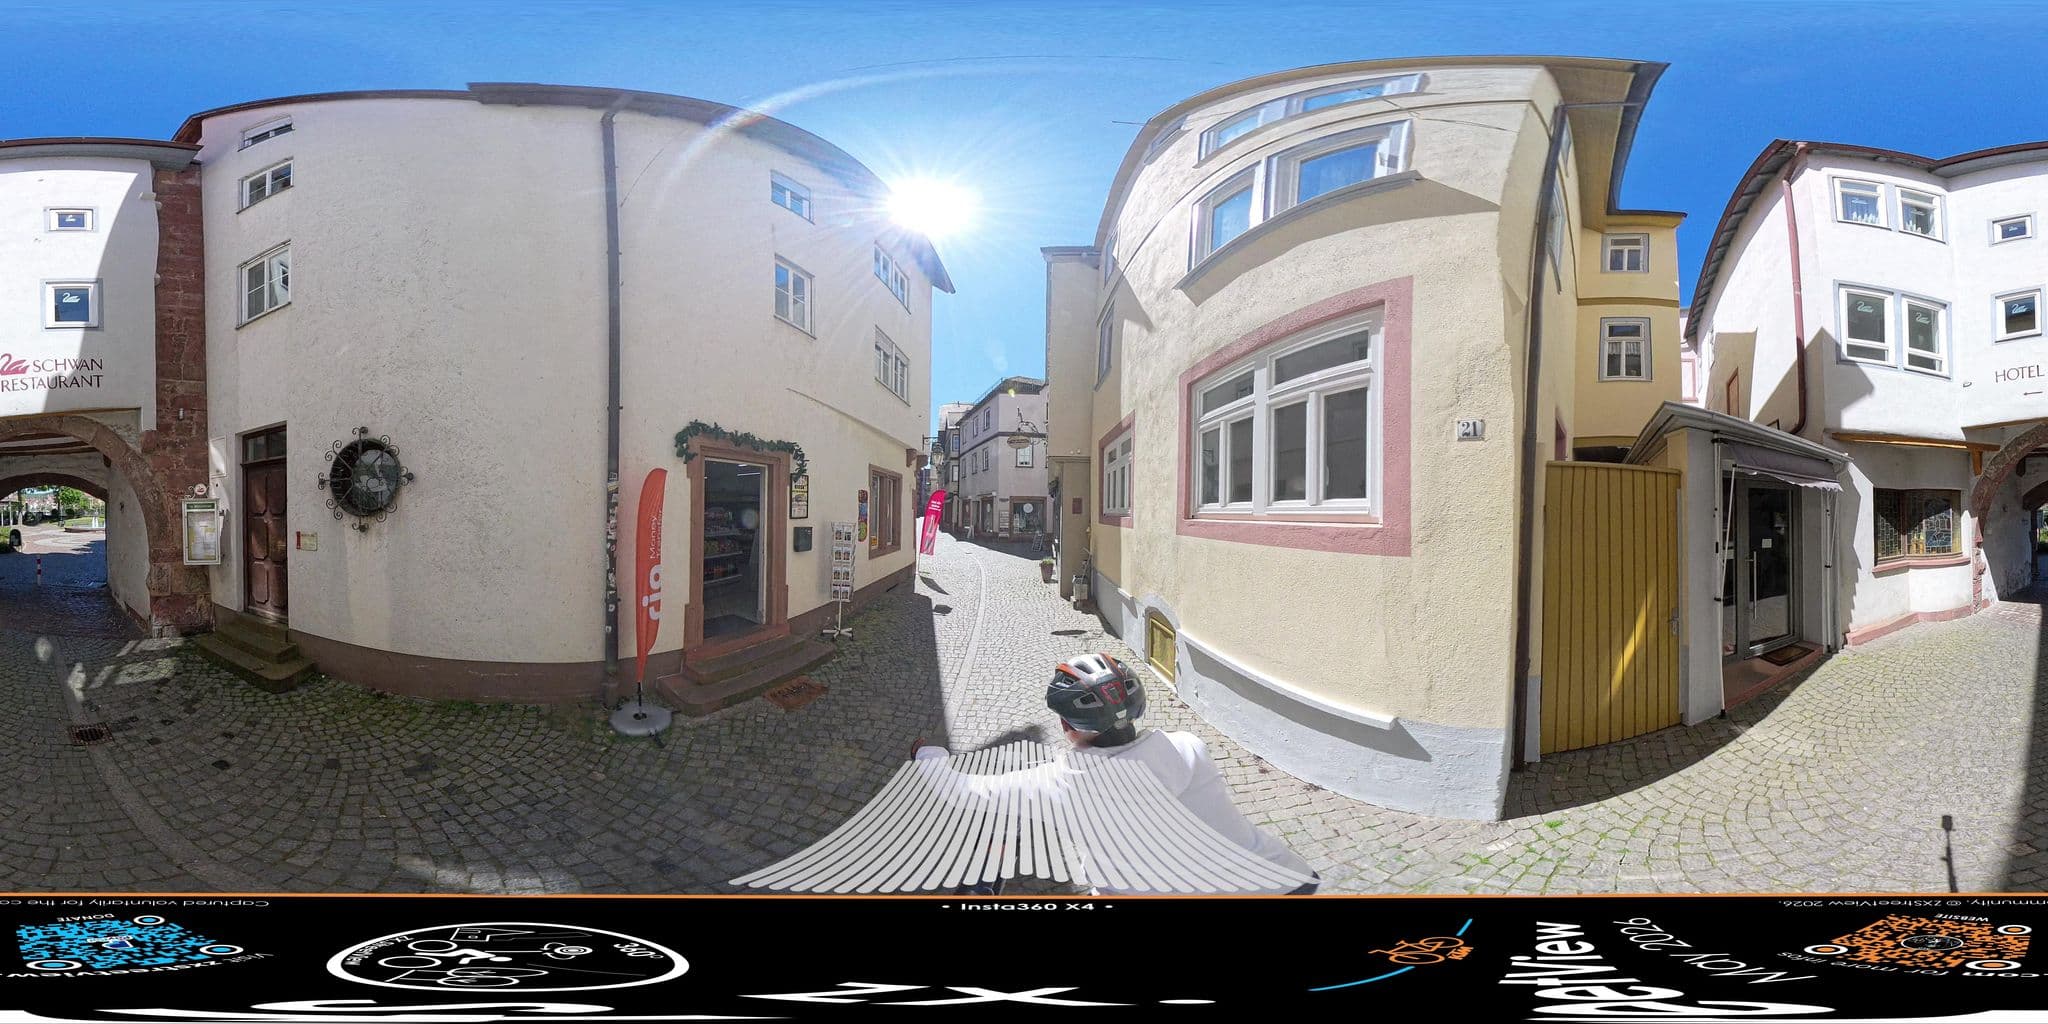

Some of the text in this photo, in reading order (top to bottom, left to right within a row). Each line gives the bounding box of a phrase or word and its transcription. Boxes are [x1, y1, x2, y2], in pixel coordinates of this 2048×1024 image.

[33, 358, 103, 372] SCHWAN
[1995, 365, 2045, 383] HOTEL
[1, 374, 103, 392] RESTAURANT
[1462, 421, 1478, 437] 21
[649, 515, 658, 559] Money
